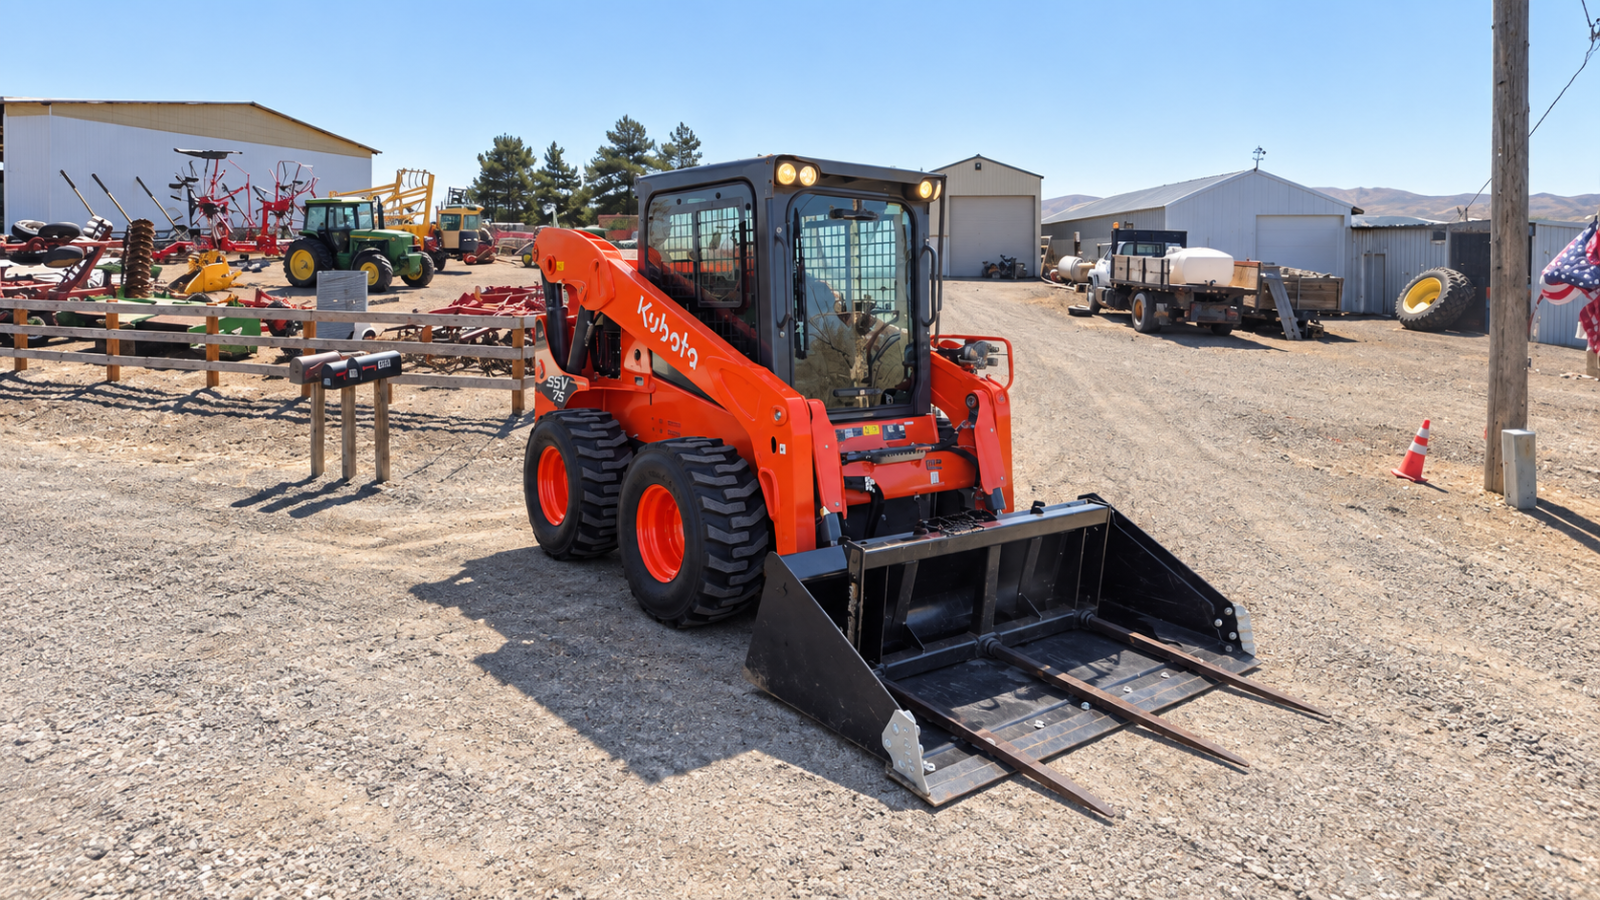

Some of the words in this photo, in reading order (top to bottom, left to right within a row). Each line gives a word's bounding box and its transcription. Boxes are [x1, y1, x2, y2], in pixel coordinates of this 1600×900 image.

[637, 295, 698, 370] Kubota
[546, 375, 569, 390] SSV
[553, 389, 565, 402] 75
